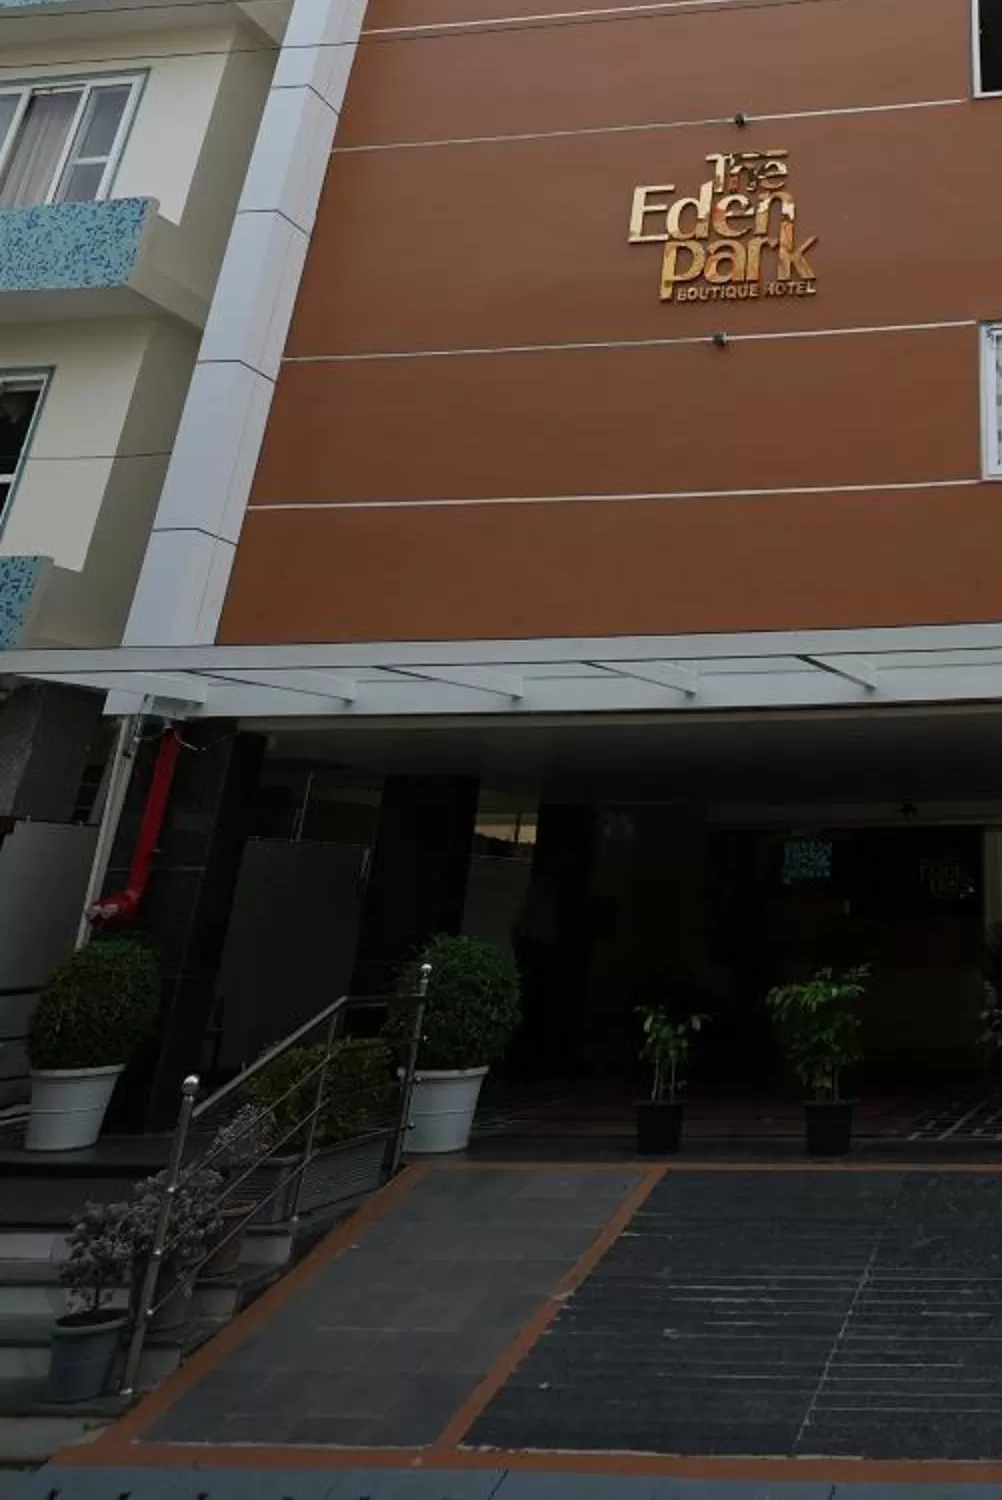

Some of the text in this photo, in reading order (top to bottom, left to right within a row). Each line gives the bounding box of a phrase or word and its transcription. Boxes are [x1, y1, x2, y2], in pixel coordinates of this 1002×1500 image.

[627, 180, 796, 244] Eden
[677, 280, 816, 301] BOUTIQUE HOTEL
